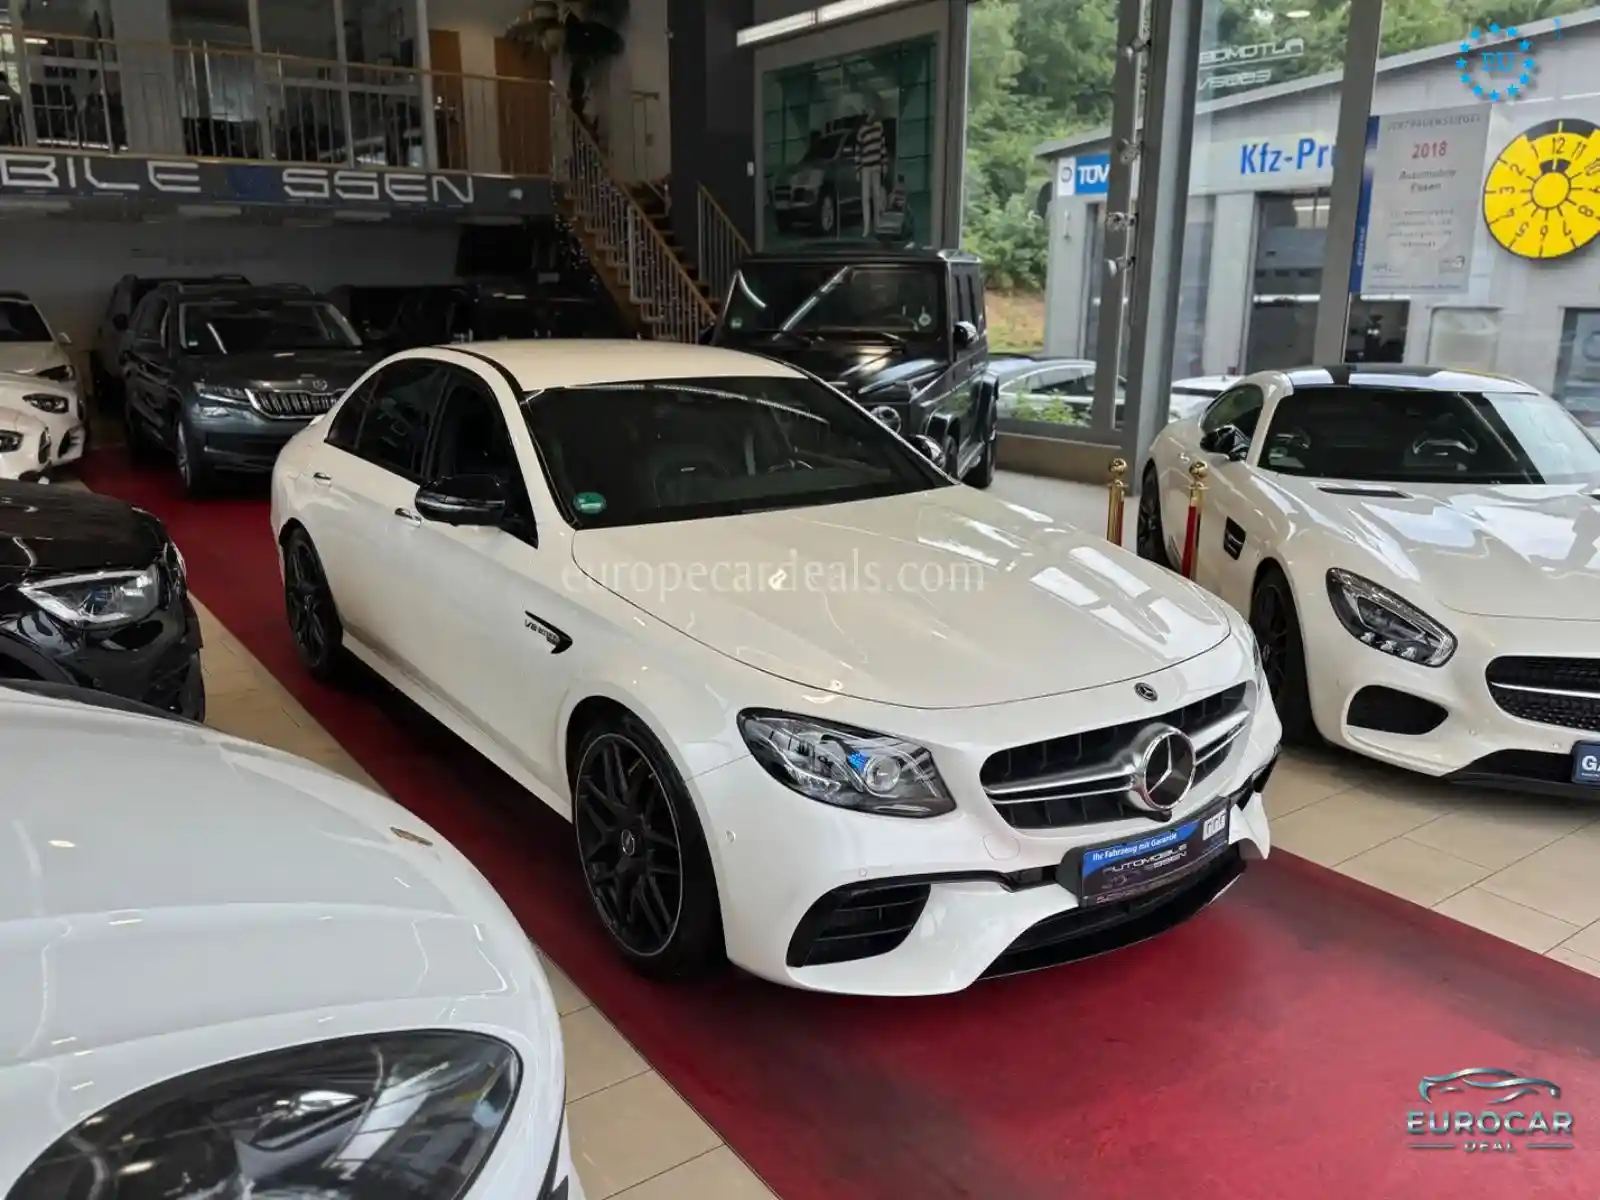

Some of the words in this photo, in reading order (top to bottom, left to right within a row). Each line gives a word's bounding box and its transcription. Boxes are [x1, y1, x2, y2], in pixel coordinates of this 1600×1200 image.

[1412, 141, 1448, 159] 2018
[1552, 137, 1566, 154] 12
[1571, 140, 1588, 160] 11
[0, 154, 200, 193] BILE
[1510, 163, 1525, 176] 2
[1500, 186, 1515, 194] 3
[1578, 205, 1594, 218] 8
[1515, 221, 1529, 237] 5
[1540, 225, 1549, 241] 6
[1104, 844, 1138, 860] Fahrzeug
